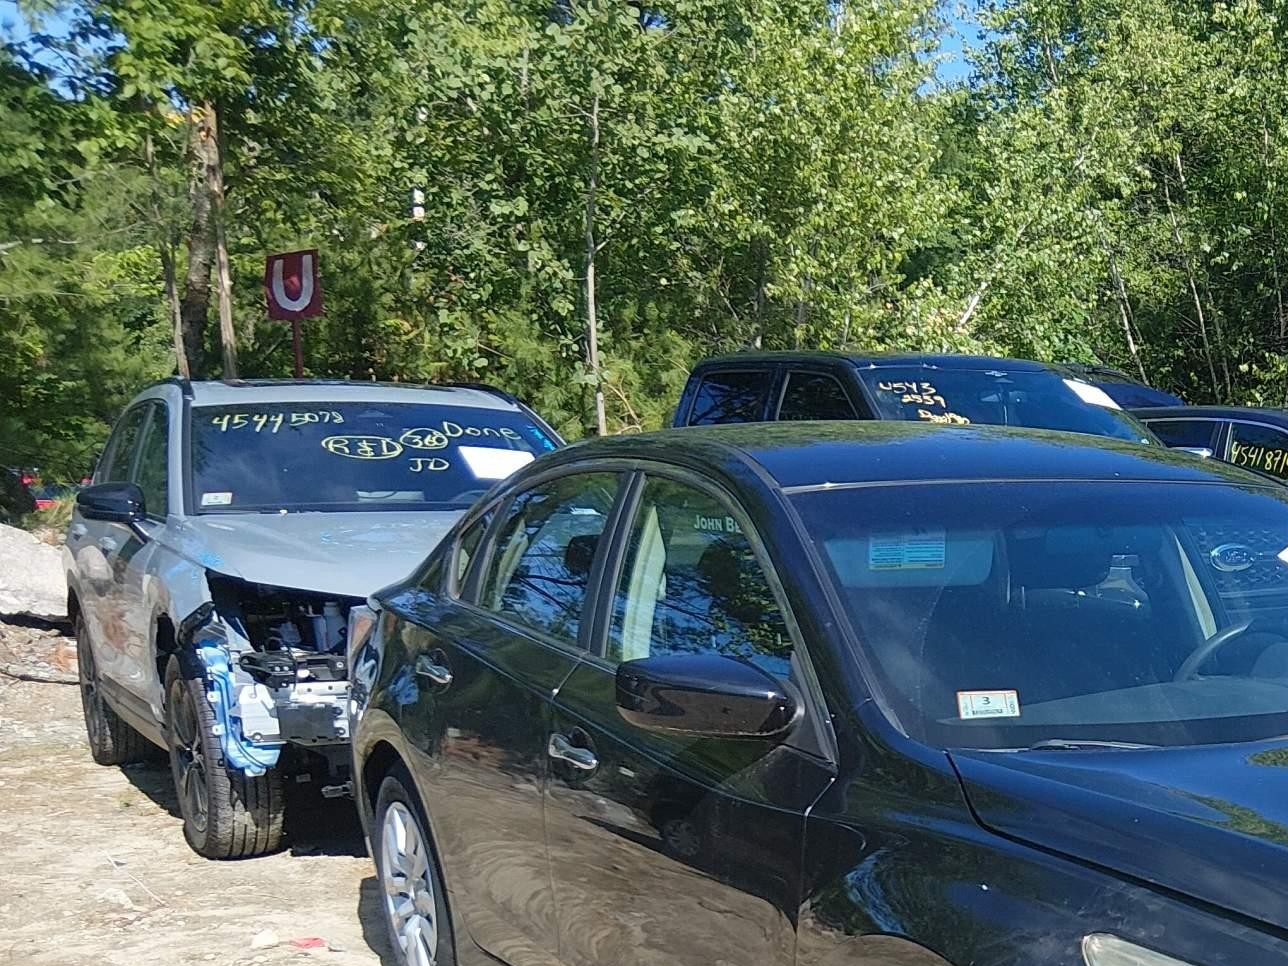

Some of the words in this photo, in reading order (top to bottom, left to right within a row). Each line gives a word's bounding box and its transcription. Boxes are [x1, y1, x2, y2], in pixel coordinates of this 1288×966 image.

[272, 254, 314, 312] U
[442, 421, 522, 440] Done
[408, 458, 449, 472] JD
[694, 514, 723, 532] JOHN
